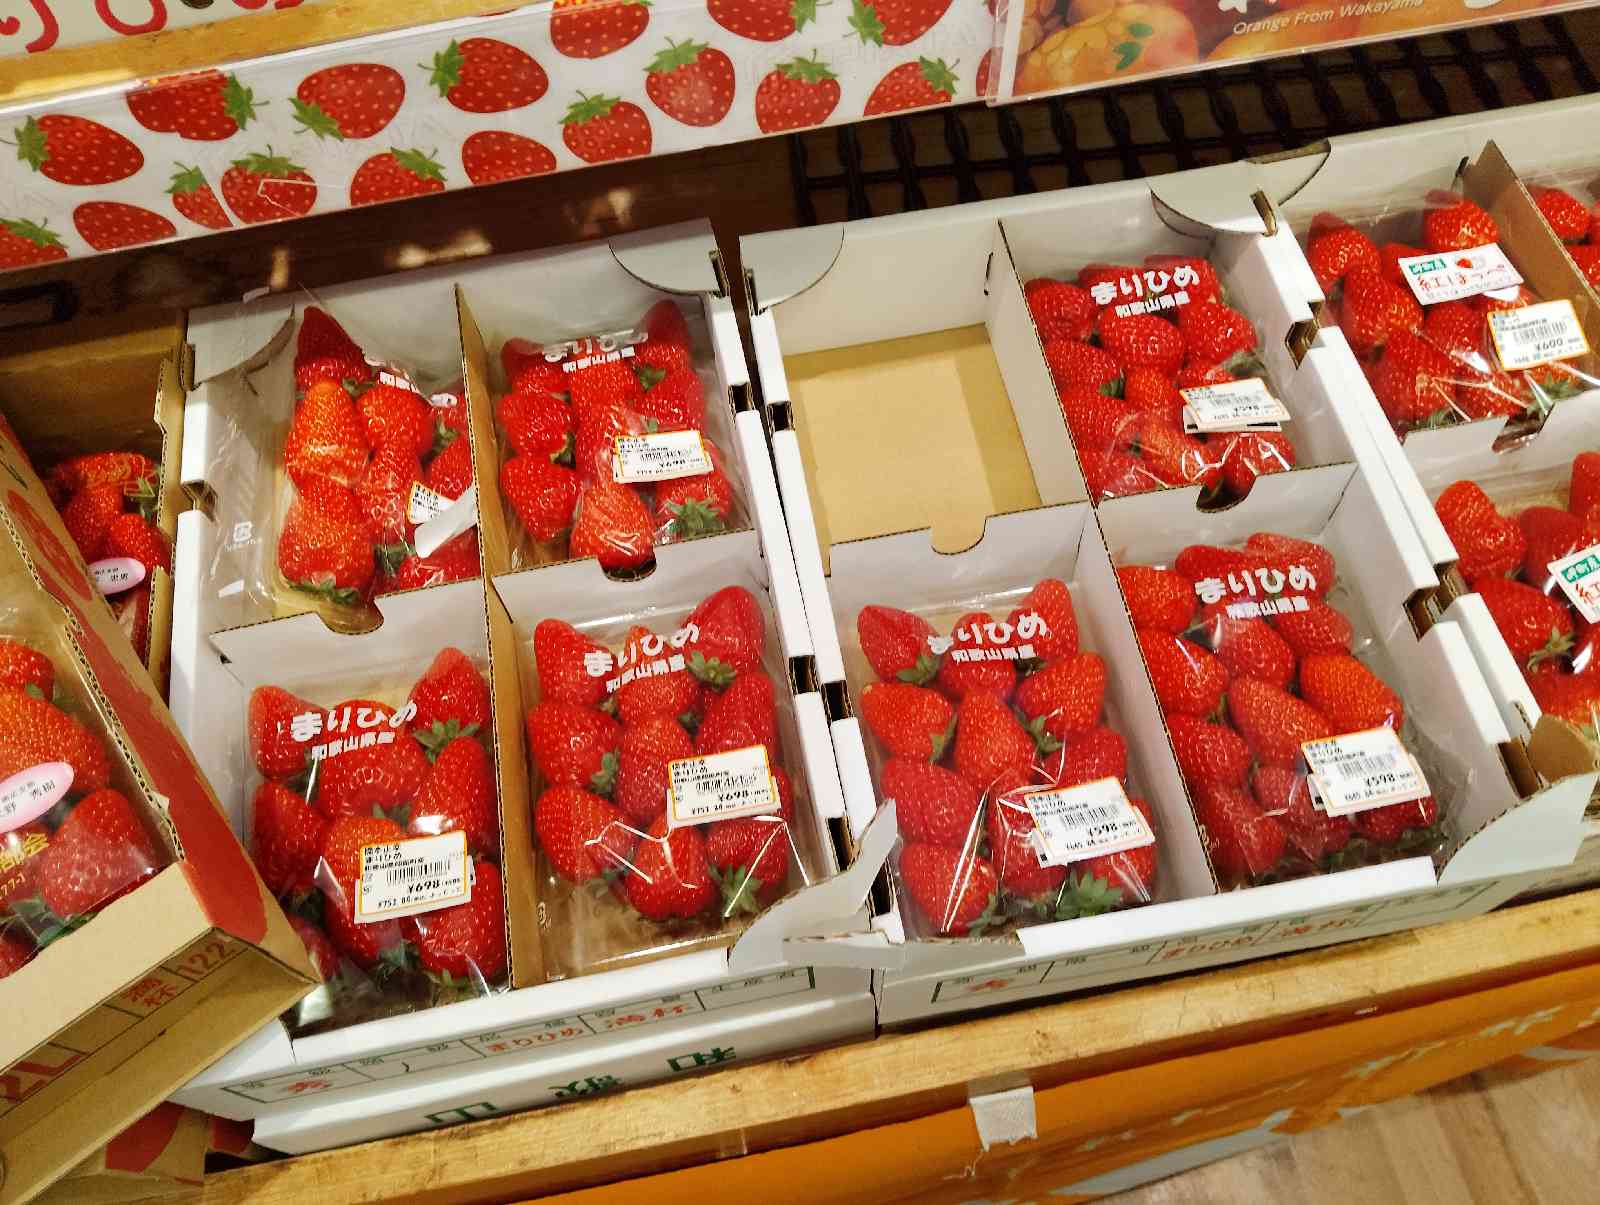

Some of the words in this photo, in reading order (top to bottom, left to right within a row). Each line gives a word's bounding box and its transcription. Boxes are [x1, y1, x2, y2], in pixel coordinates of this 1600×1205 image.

[1233, 16, 1290, 34] Orange
[1294, 9, 1334, 24] From
[1340, 0, 1424, 17] Wakayama
[1090, 265, 1200, 304] まりひめ
[1194, 565, 1317, 604] まりひめ
[583, 621, 700, 677] まりひめ
[290, 700, 417, 742] まりひめ
[719, 790, 749, 802] ¥698
[1365, 773, 1396, 787] ¥598
[1089, 823, 1118, 837] ¥598
[408, 880, 440, 893] ¥698
